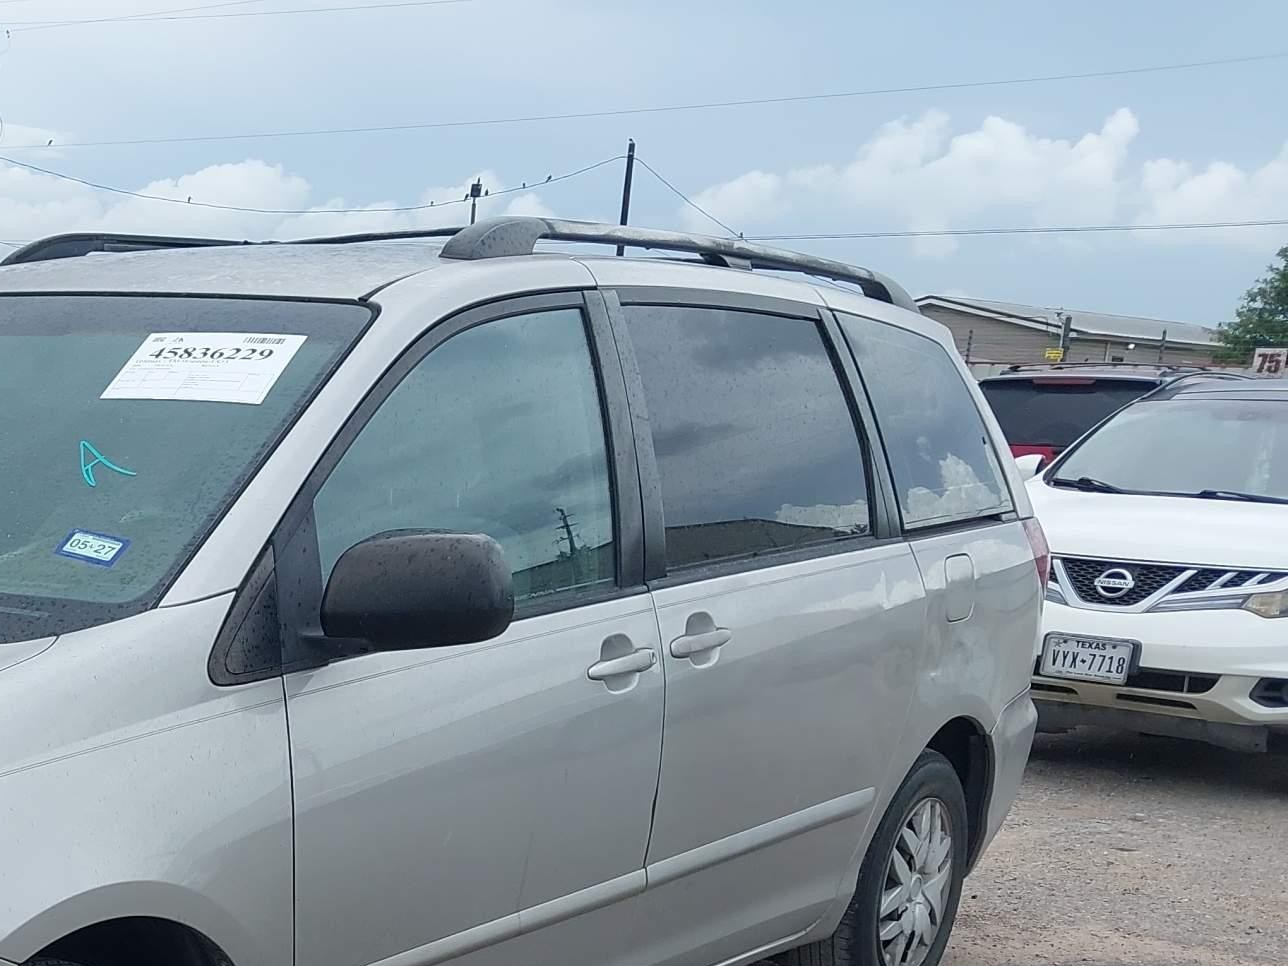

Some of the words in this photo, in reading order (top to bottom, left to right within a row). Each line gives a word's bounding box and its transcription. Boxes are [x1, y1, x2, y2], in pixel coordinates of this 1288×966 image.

[149, 346, 274, 361] 45836229
[1256, 353, 1282, 374] 75
[1096, 578, 1130, 587] NISSAN
[1075, 640, 1107, 651] TEXAS
